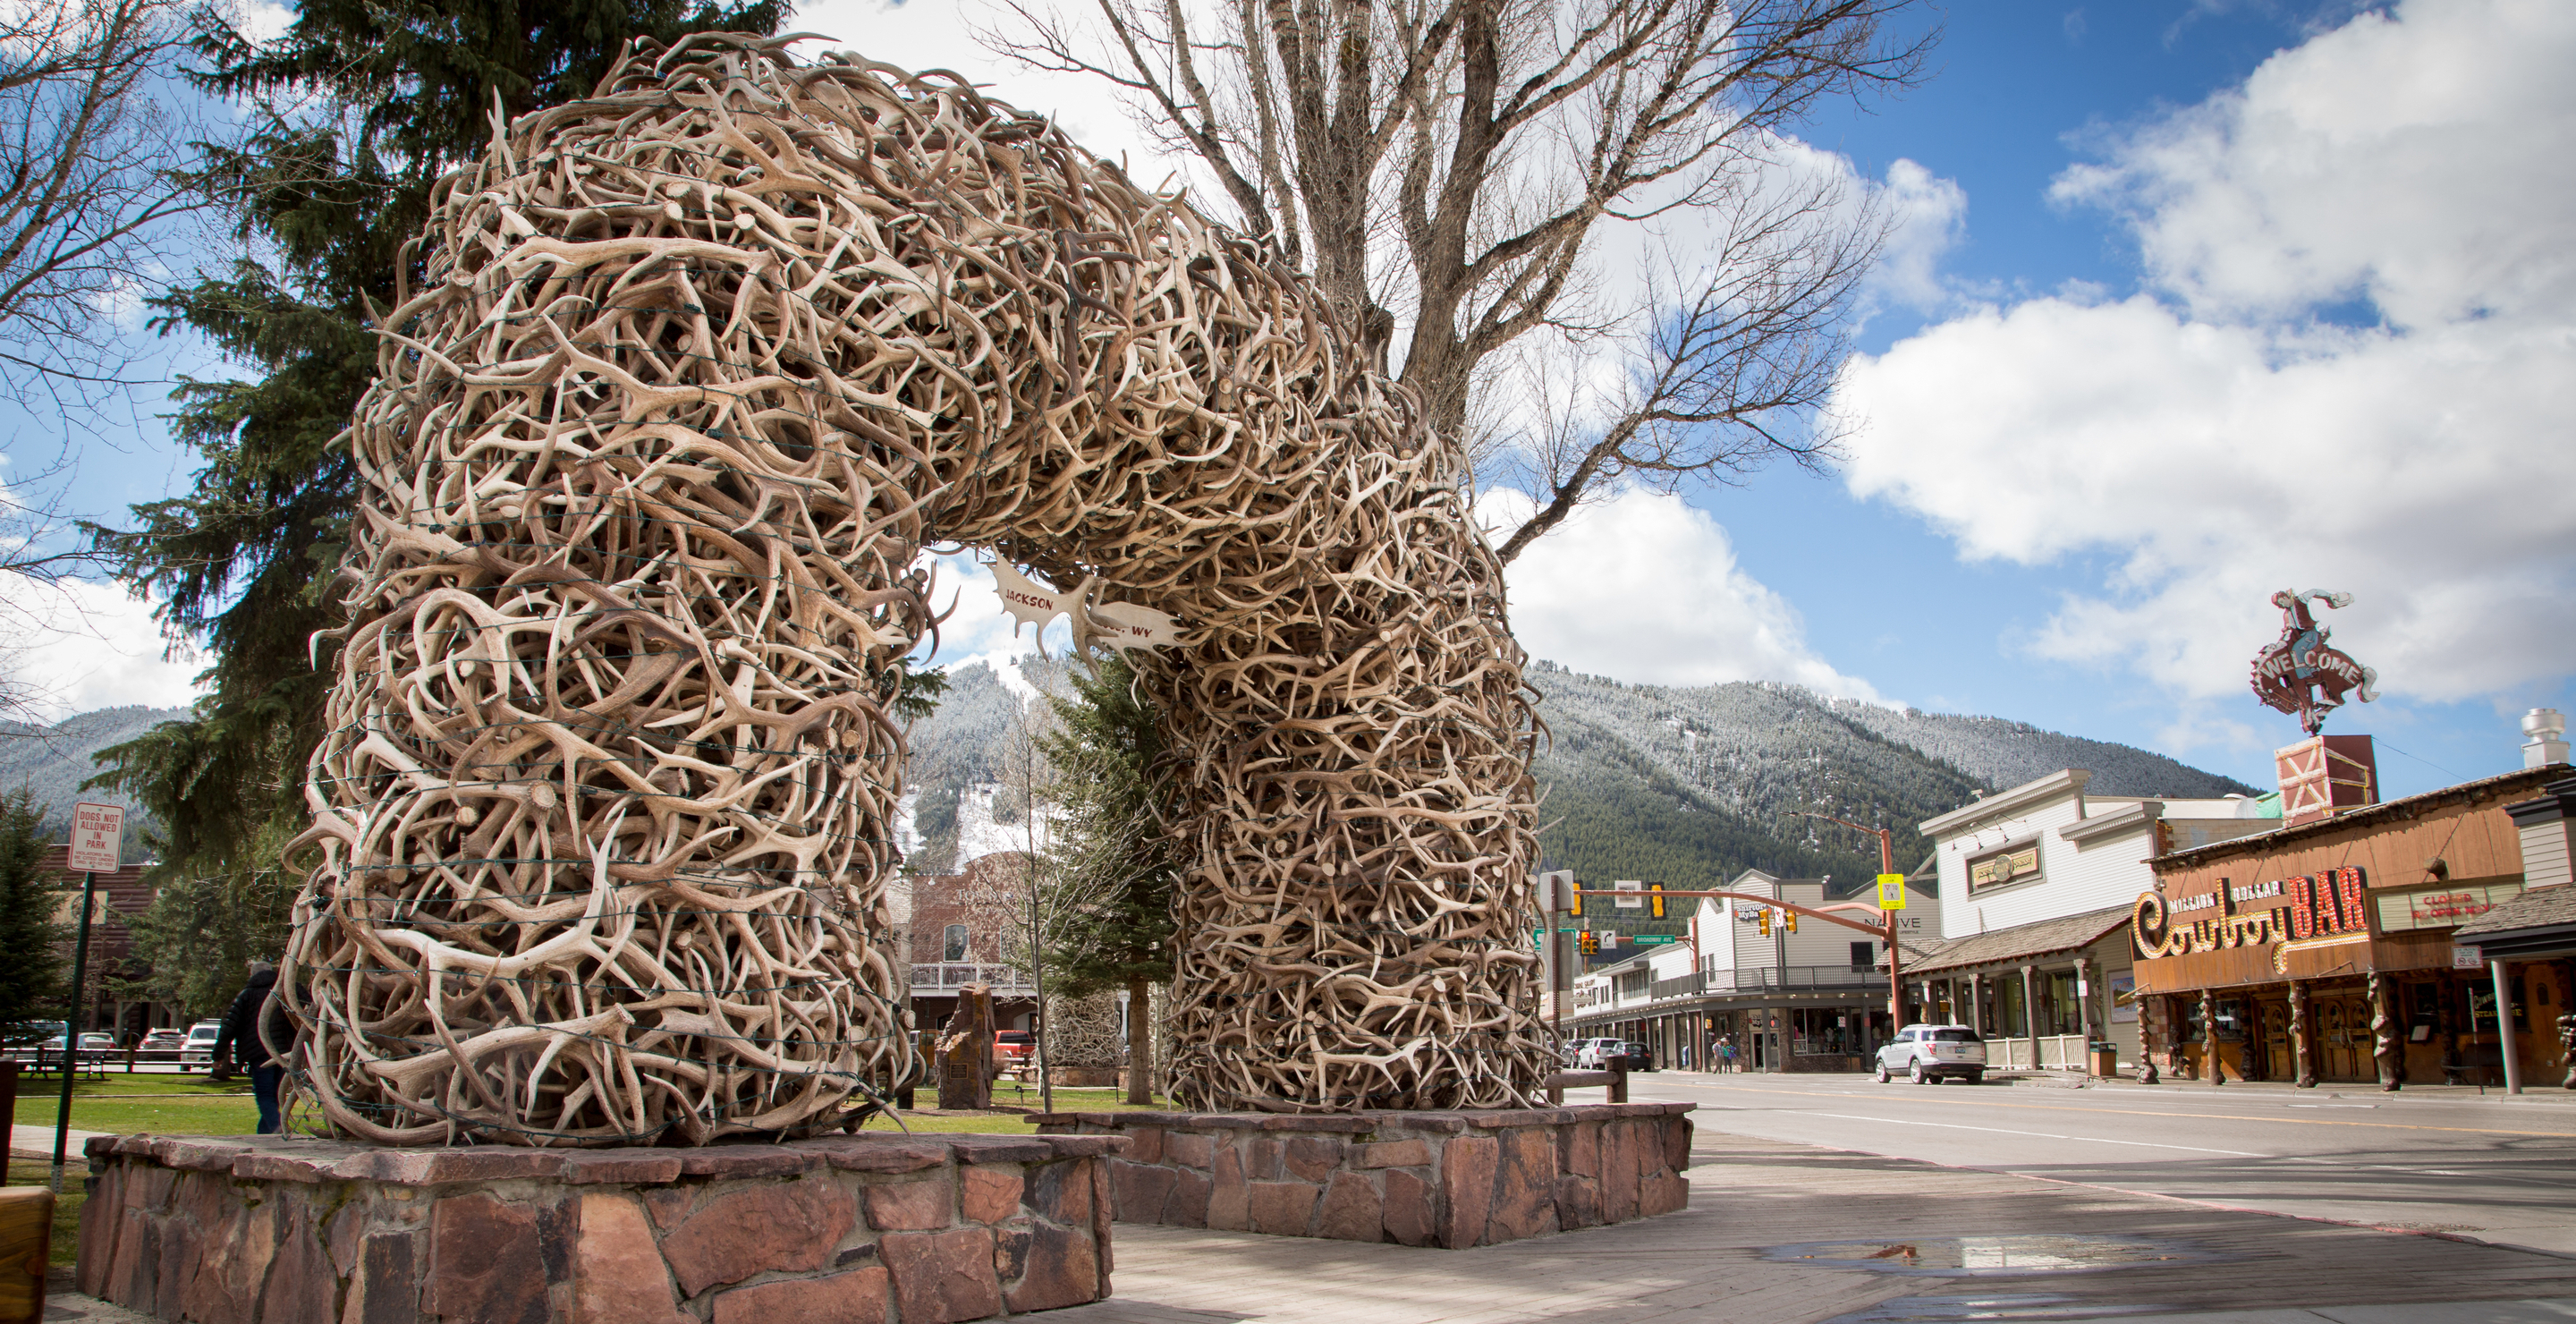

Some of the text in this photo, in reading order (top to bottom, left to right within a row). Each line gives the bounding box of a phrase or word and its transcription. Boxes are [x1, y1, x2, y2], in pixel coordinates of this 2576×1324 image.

[1005, 589, 1054, 610] JACKSON
[1131, 625, 1152, 638] WY
[2259, 650, 2361, 685] WELCOME
[80, 811, 120, 823] DOGS NOT
[80, 820, 117, 833] ALLOWED
[93, 831, 102, 840] IN
[86, 839, 106, 850] PARK
[2169, 880, 2281, 914] MILLION DOLLAR
[2423, 893, 2472, 905] CLOSED
[1864, 918, 1921, 928] NAIVE
[2133, 866, 2368, 974] Cowboy BAR
[2474, 992, 2496, 1009] COWBO
